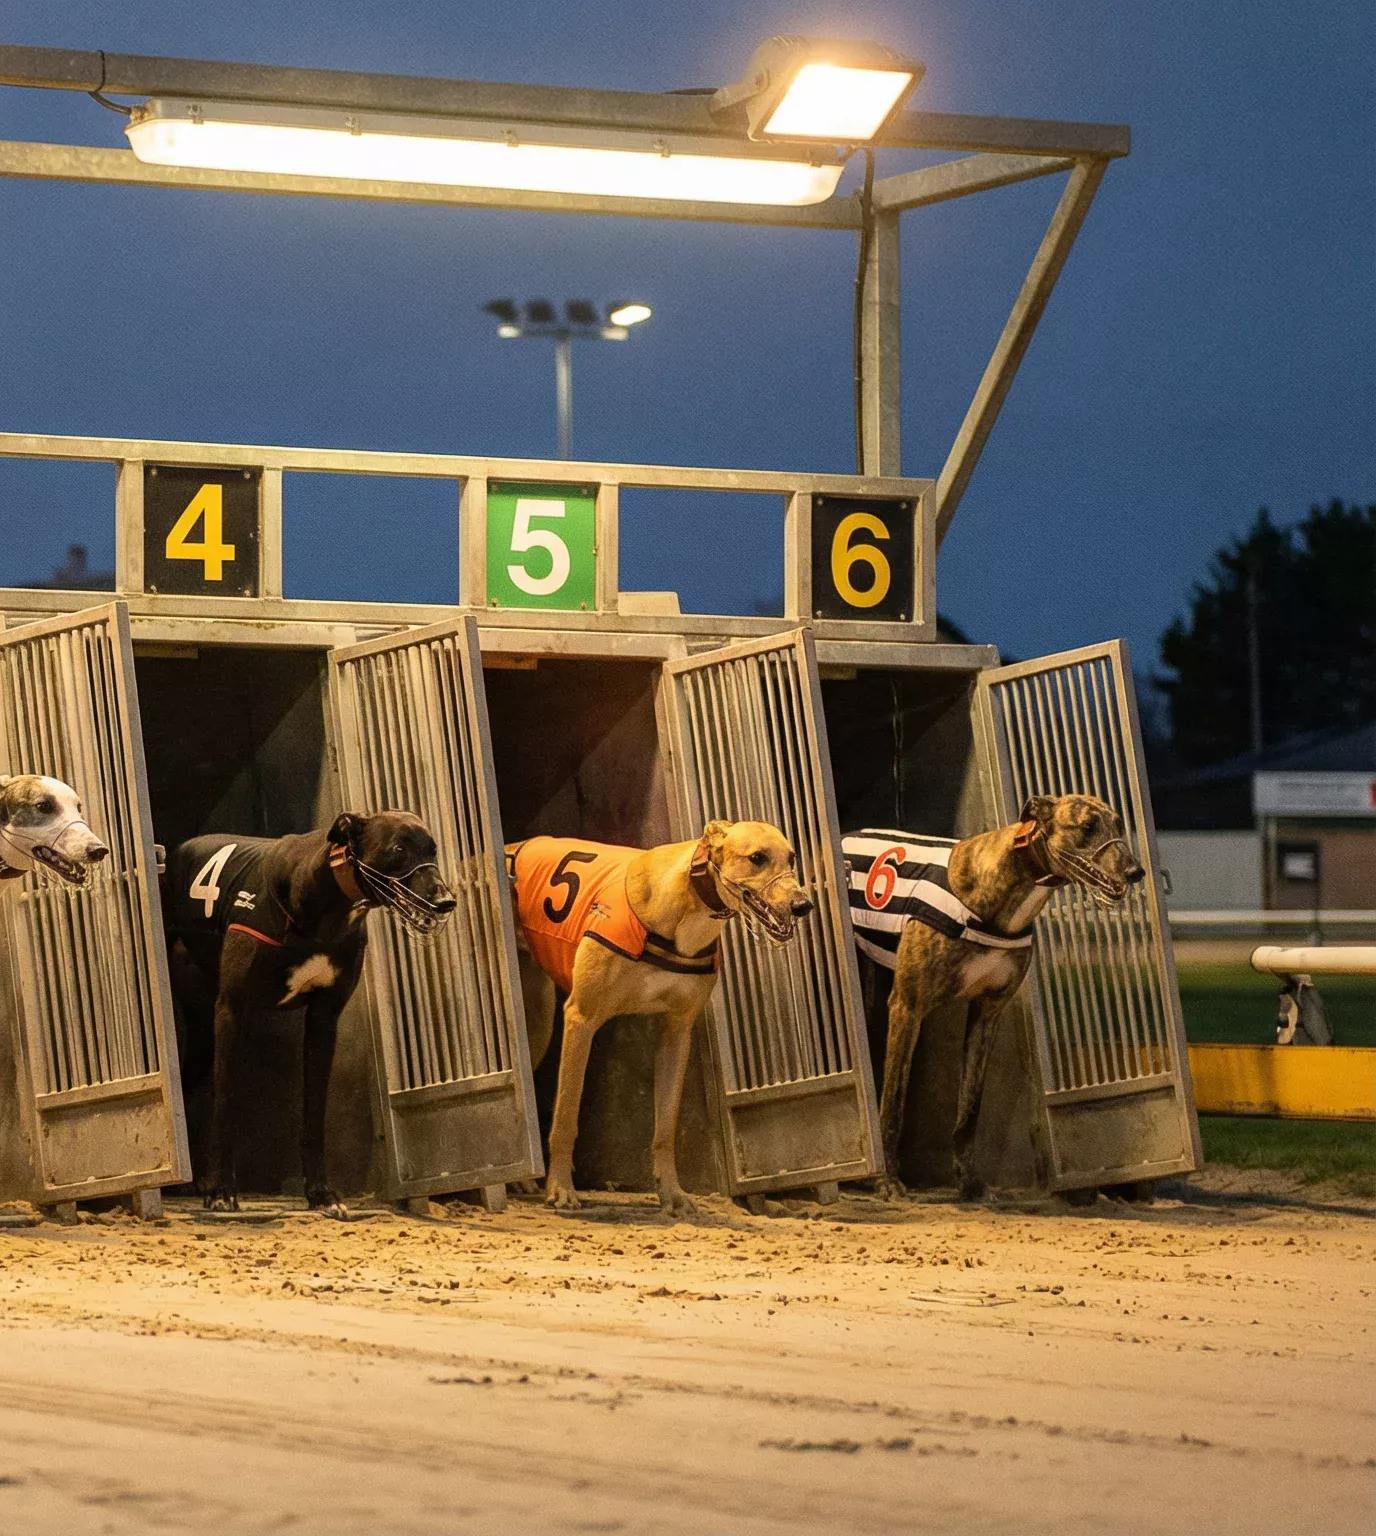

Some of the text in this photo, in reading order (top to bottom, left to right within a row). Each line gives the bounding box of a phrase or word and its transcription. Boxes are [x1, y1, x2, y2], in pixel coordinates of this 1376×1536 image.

[165, 483, 236, 581] 4
[505, 497, 576, 596] 5
[830, 512, 891, 608] 6
[189, 843, 237, 918] 4
[542, 851, 598, 924] 5
[865, 846, 907, 910] 6
